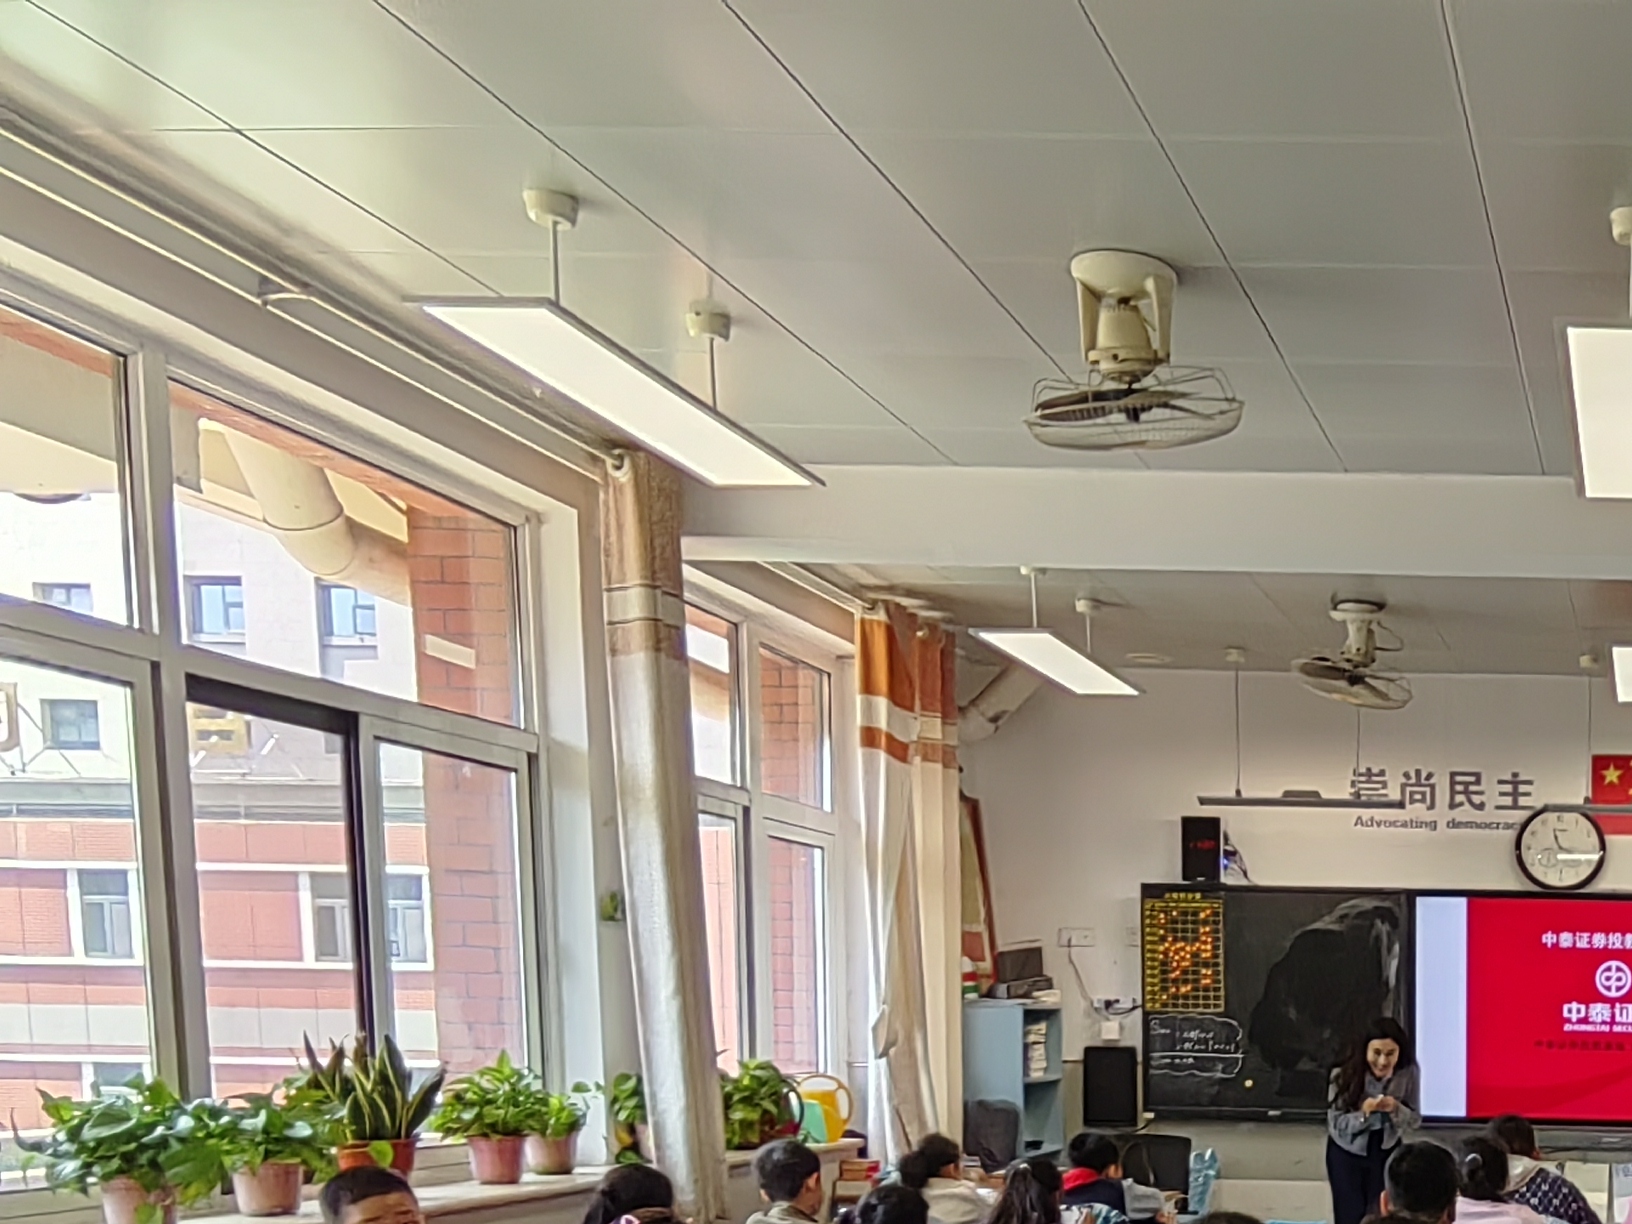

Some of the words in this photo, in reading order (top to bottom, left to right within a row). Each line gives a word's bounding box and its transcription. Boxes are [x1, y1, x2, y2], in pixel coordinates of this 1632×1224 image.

[1349, 767, 1536, 811] 崇尚民主
[1354, 815, 1438, 831] Advocating
[1446, 818, 1519, 830] democrac
